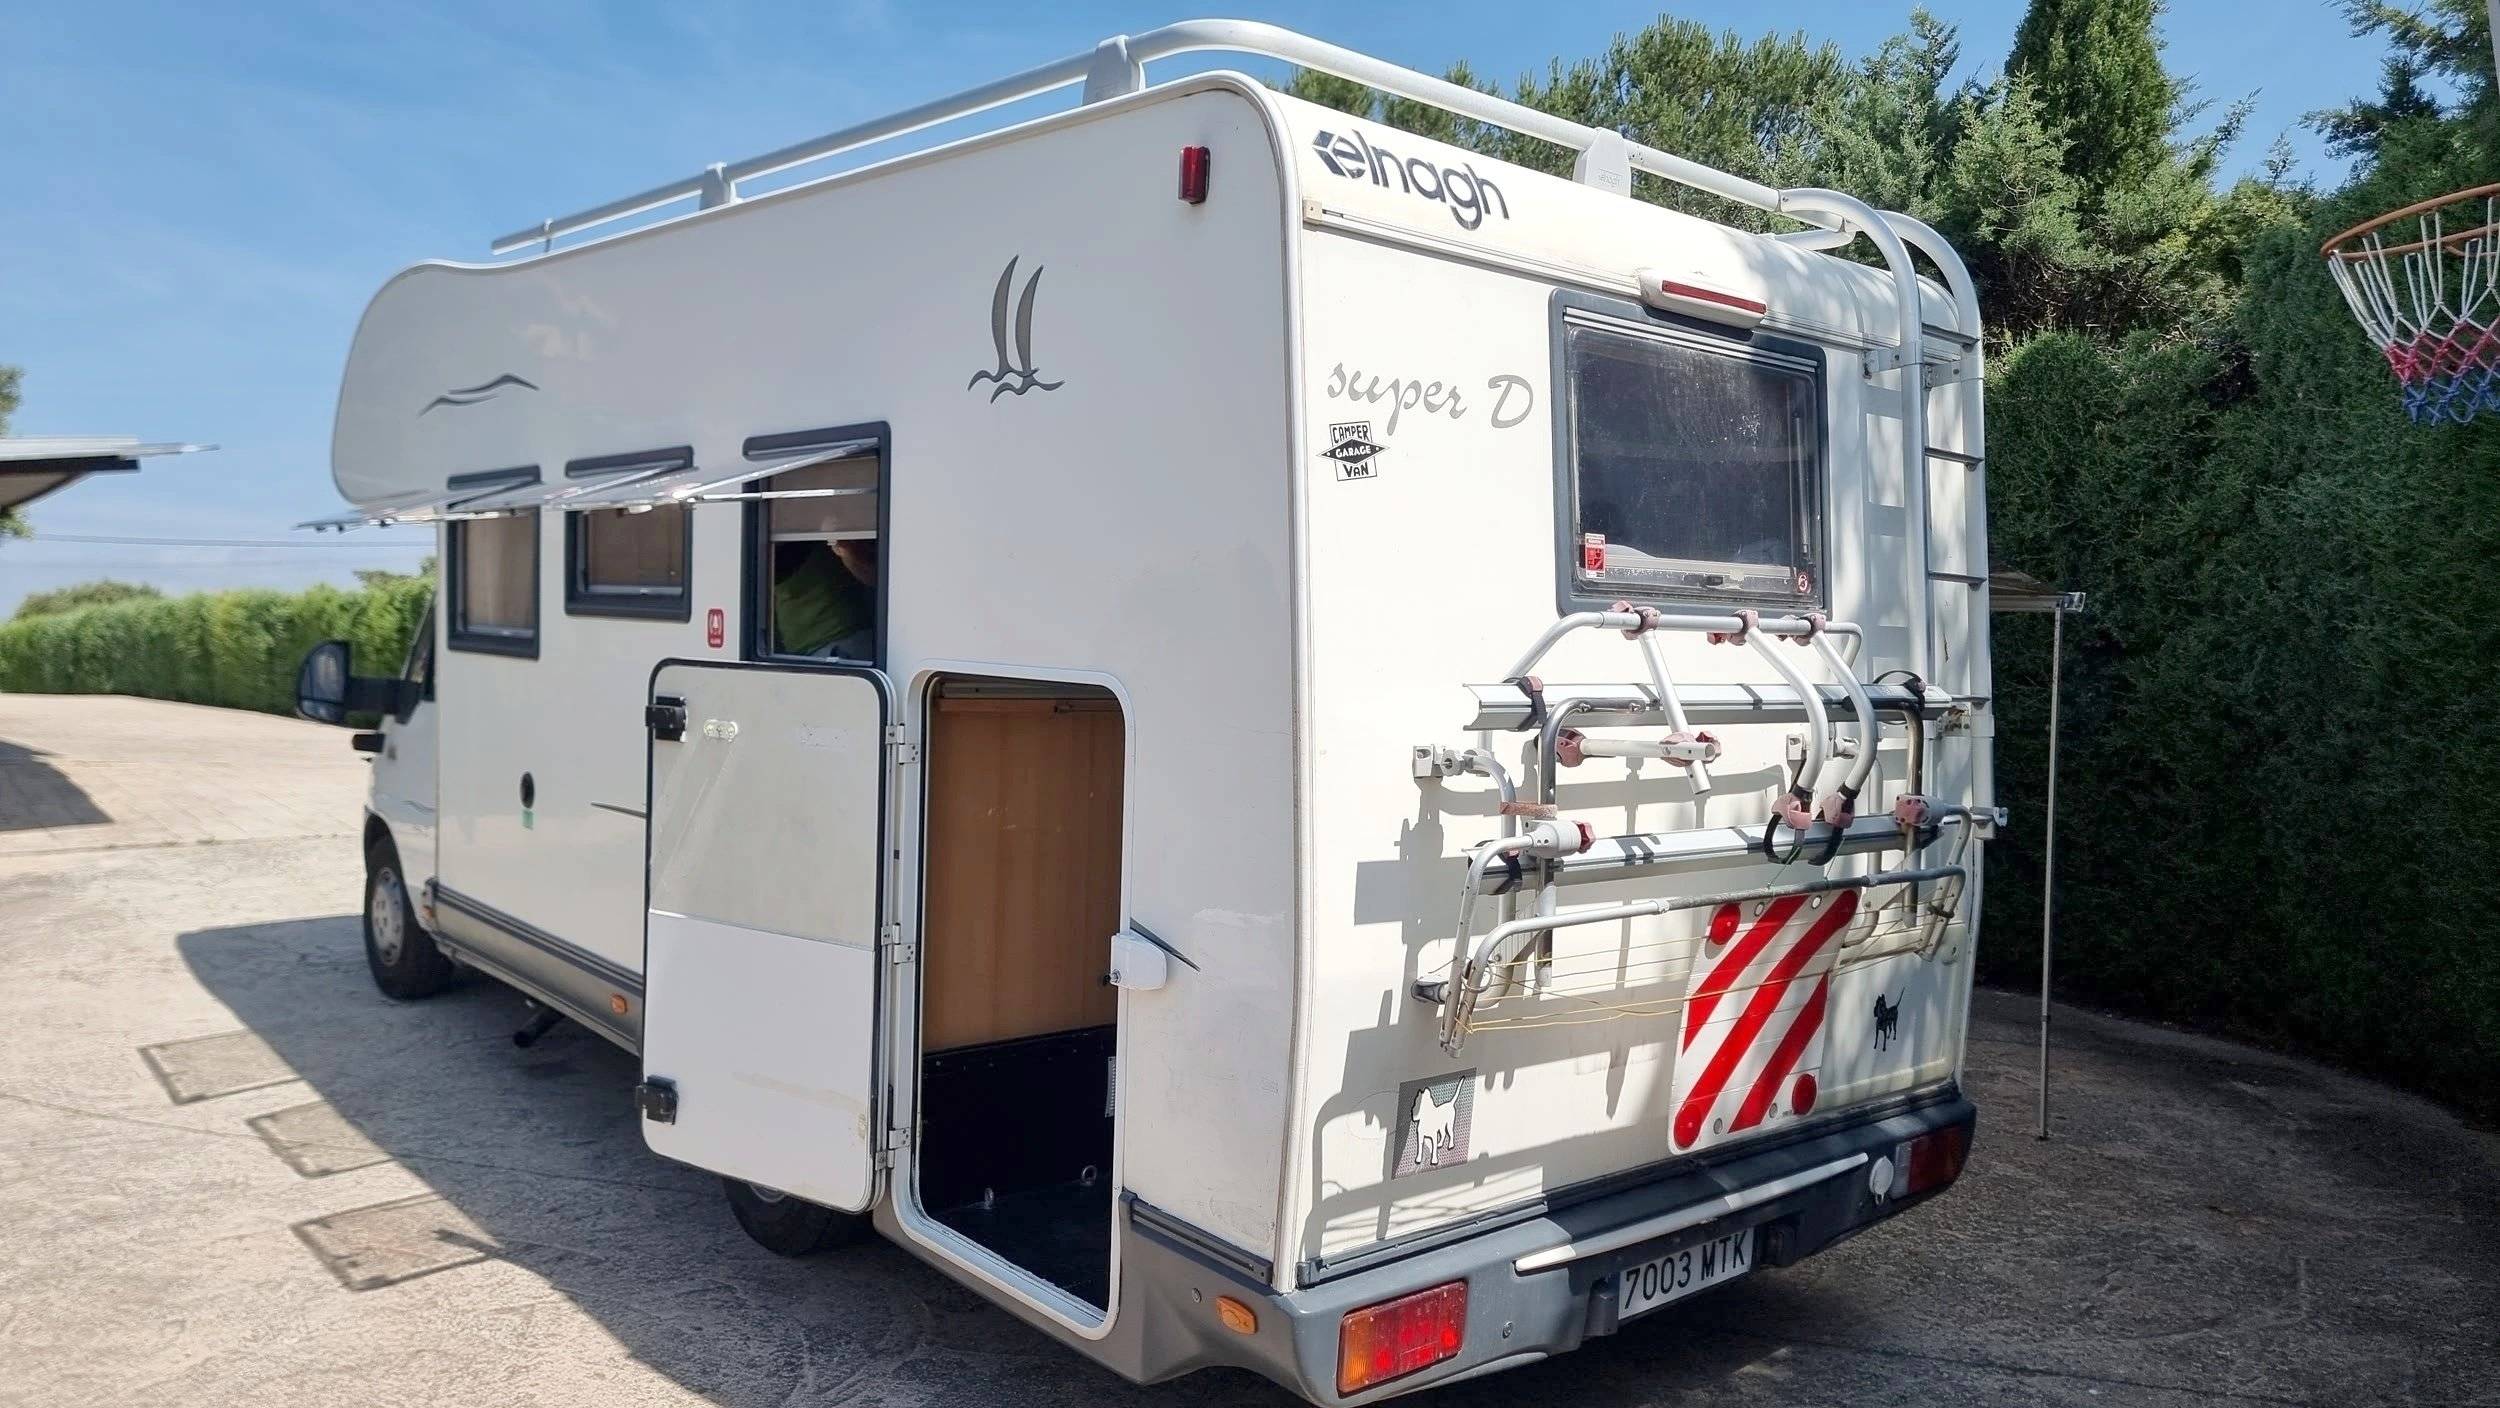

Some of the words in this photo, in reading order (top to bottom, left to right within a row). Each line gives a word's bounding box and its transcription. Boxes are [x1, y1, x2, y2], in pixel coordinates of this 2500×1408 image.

[1331, 129, 1510, 231] elnagh
[1327, 362, 1467, 436] super
[1488, 374, 1534, 429] D
[1332, 425, 1370, 443] CAMPER
[1335, 445, 1371, 458] GARAGE
[1342, 461, 1369, 477] VAN
[1624, 1251, 1692, 1310] 7003
[1701, 1230, 1748, 1280] MTK
